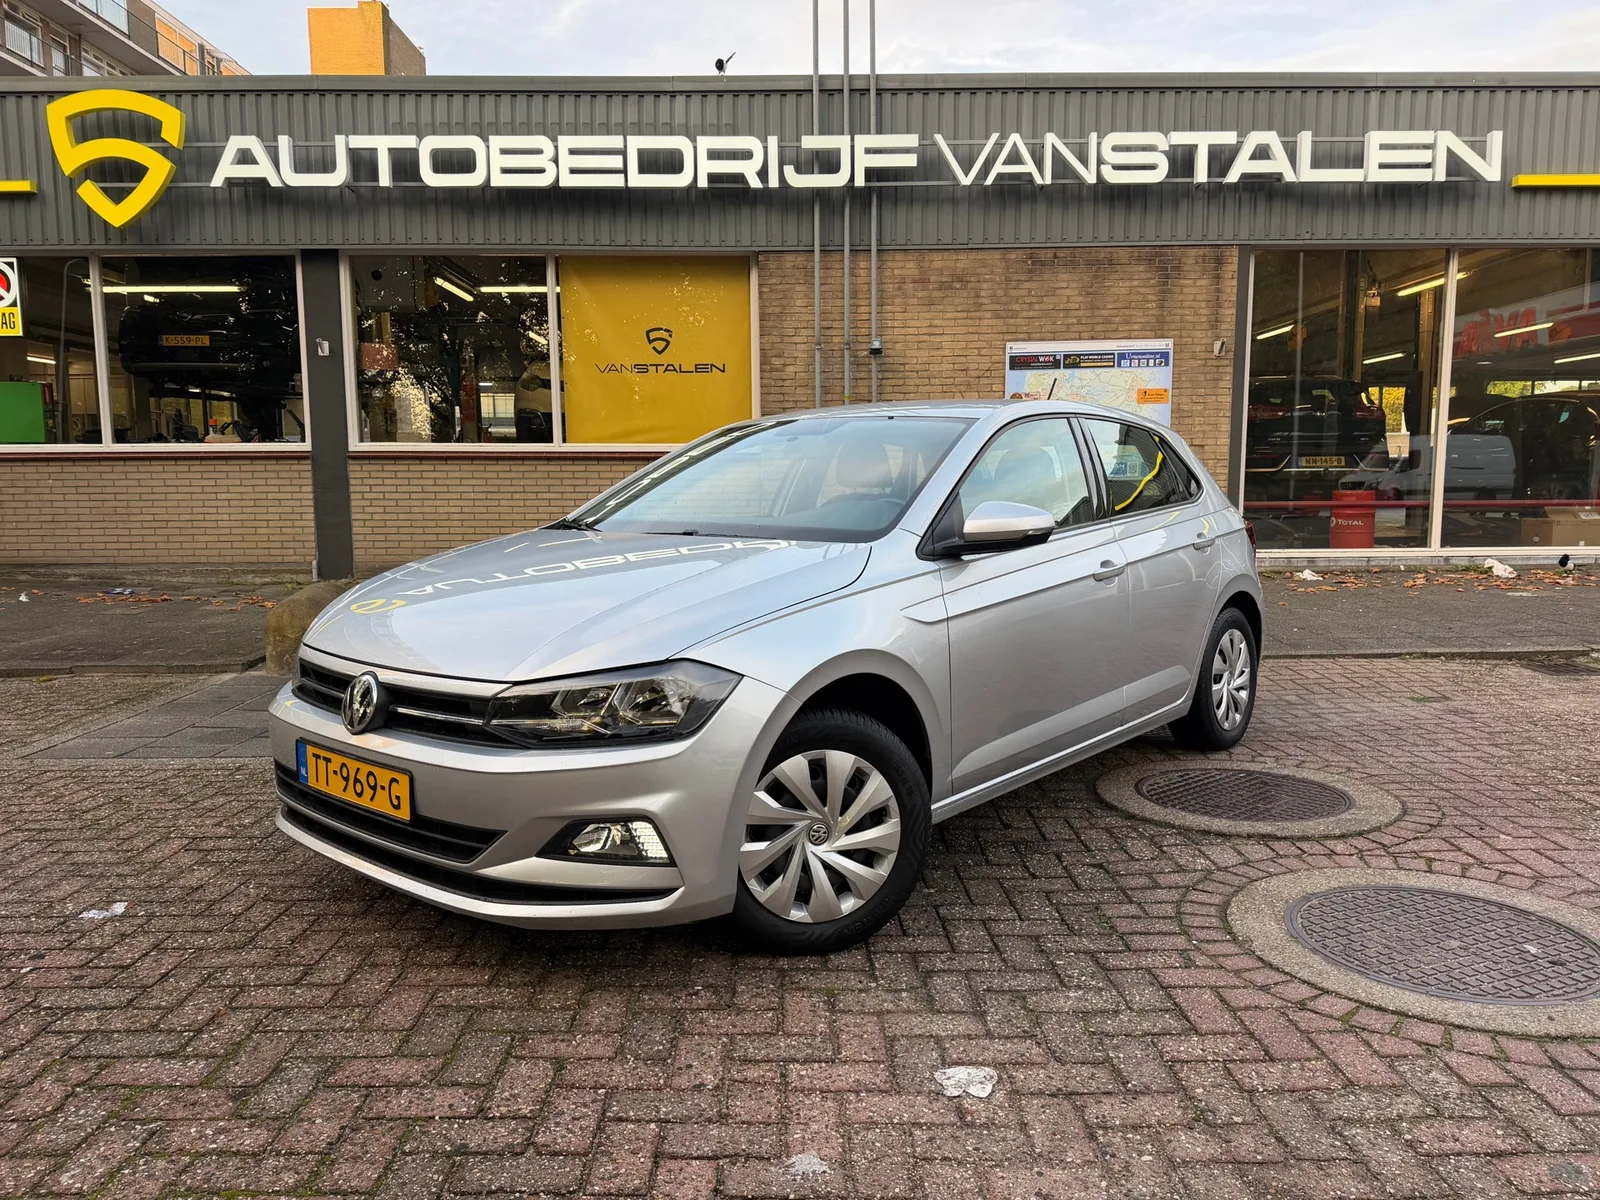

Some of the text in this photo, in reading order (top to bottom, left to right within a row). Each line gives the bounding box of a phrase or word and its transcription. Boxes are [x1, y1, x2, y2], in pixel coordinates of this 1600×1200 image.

[209, 134, 919, 189] AUTOBEDRIJF
[0, 312, 16, 330] AG
[164, 336, 207, 345] K-559-PL
[595, 363, 726, 374] VANSTALEN
[311, 752, 402, 811] TT-969-G
